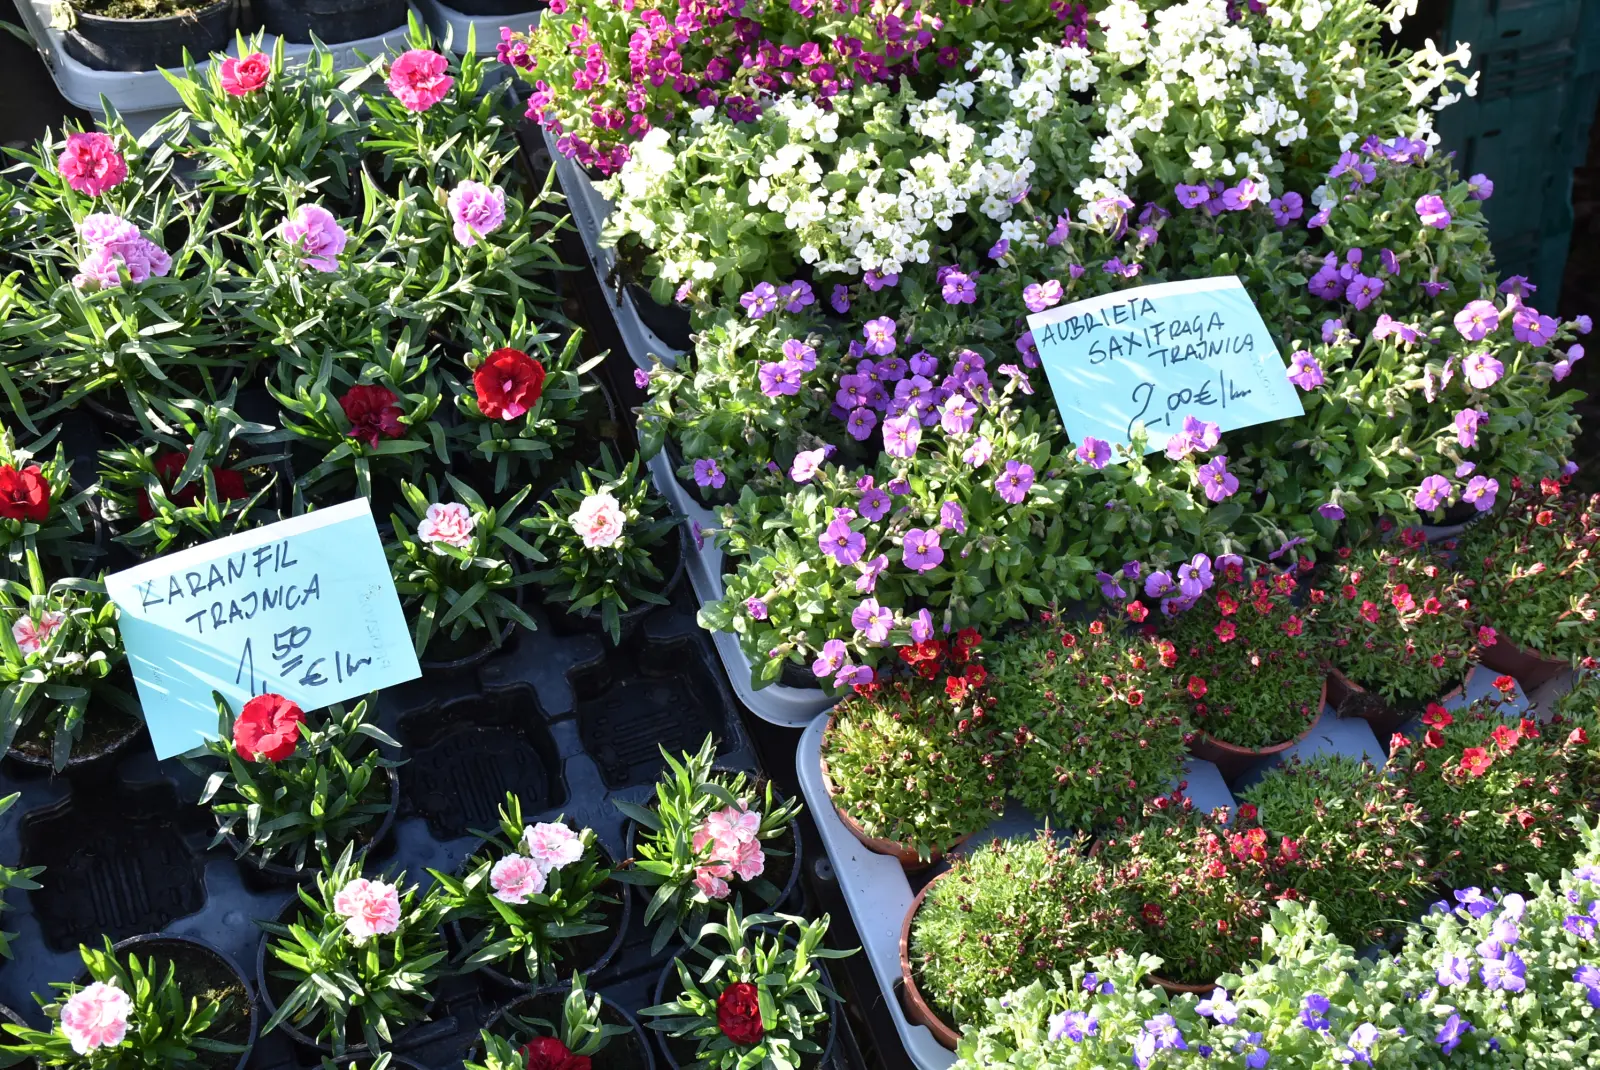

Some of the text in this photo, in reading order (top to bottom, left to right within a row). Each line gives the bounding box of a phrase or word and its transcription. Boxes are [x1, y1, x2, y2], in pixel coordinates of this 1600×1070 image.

[1042, 297, 1156, 348] AUBRIETA
[1088, 311, 1225, 365] SAXIFRAGA
[1147, 333, 1254, 367] TRAJNICA
[138, 540, 298, 613] KARANFIL
[185, 573, 320, 633] TRAJNICA
